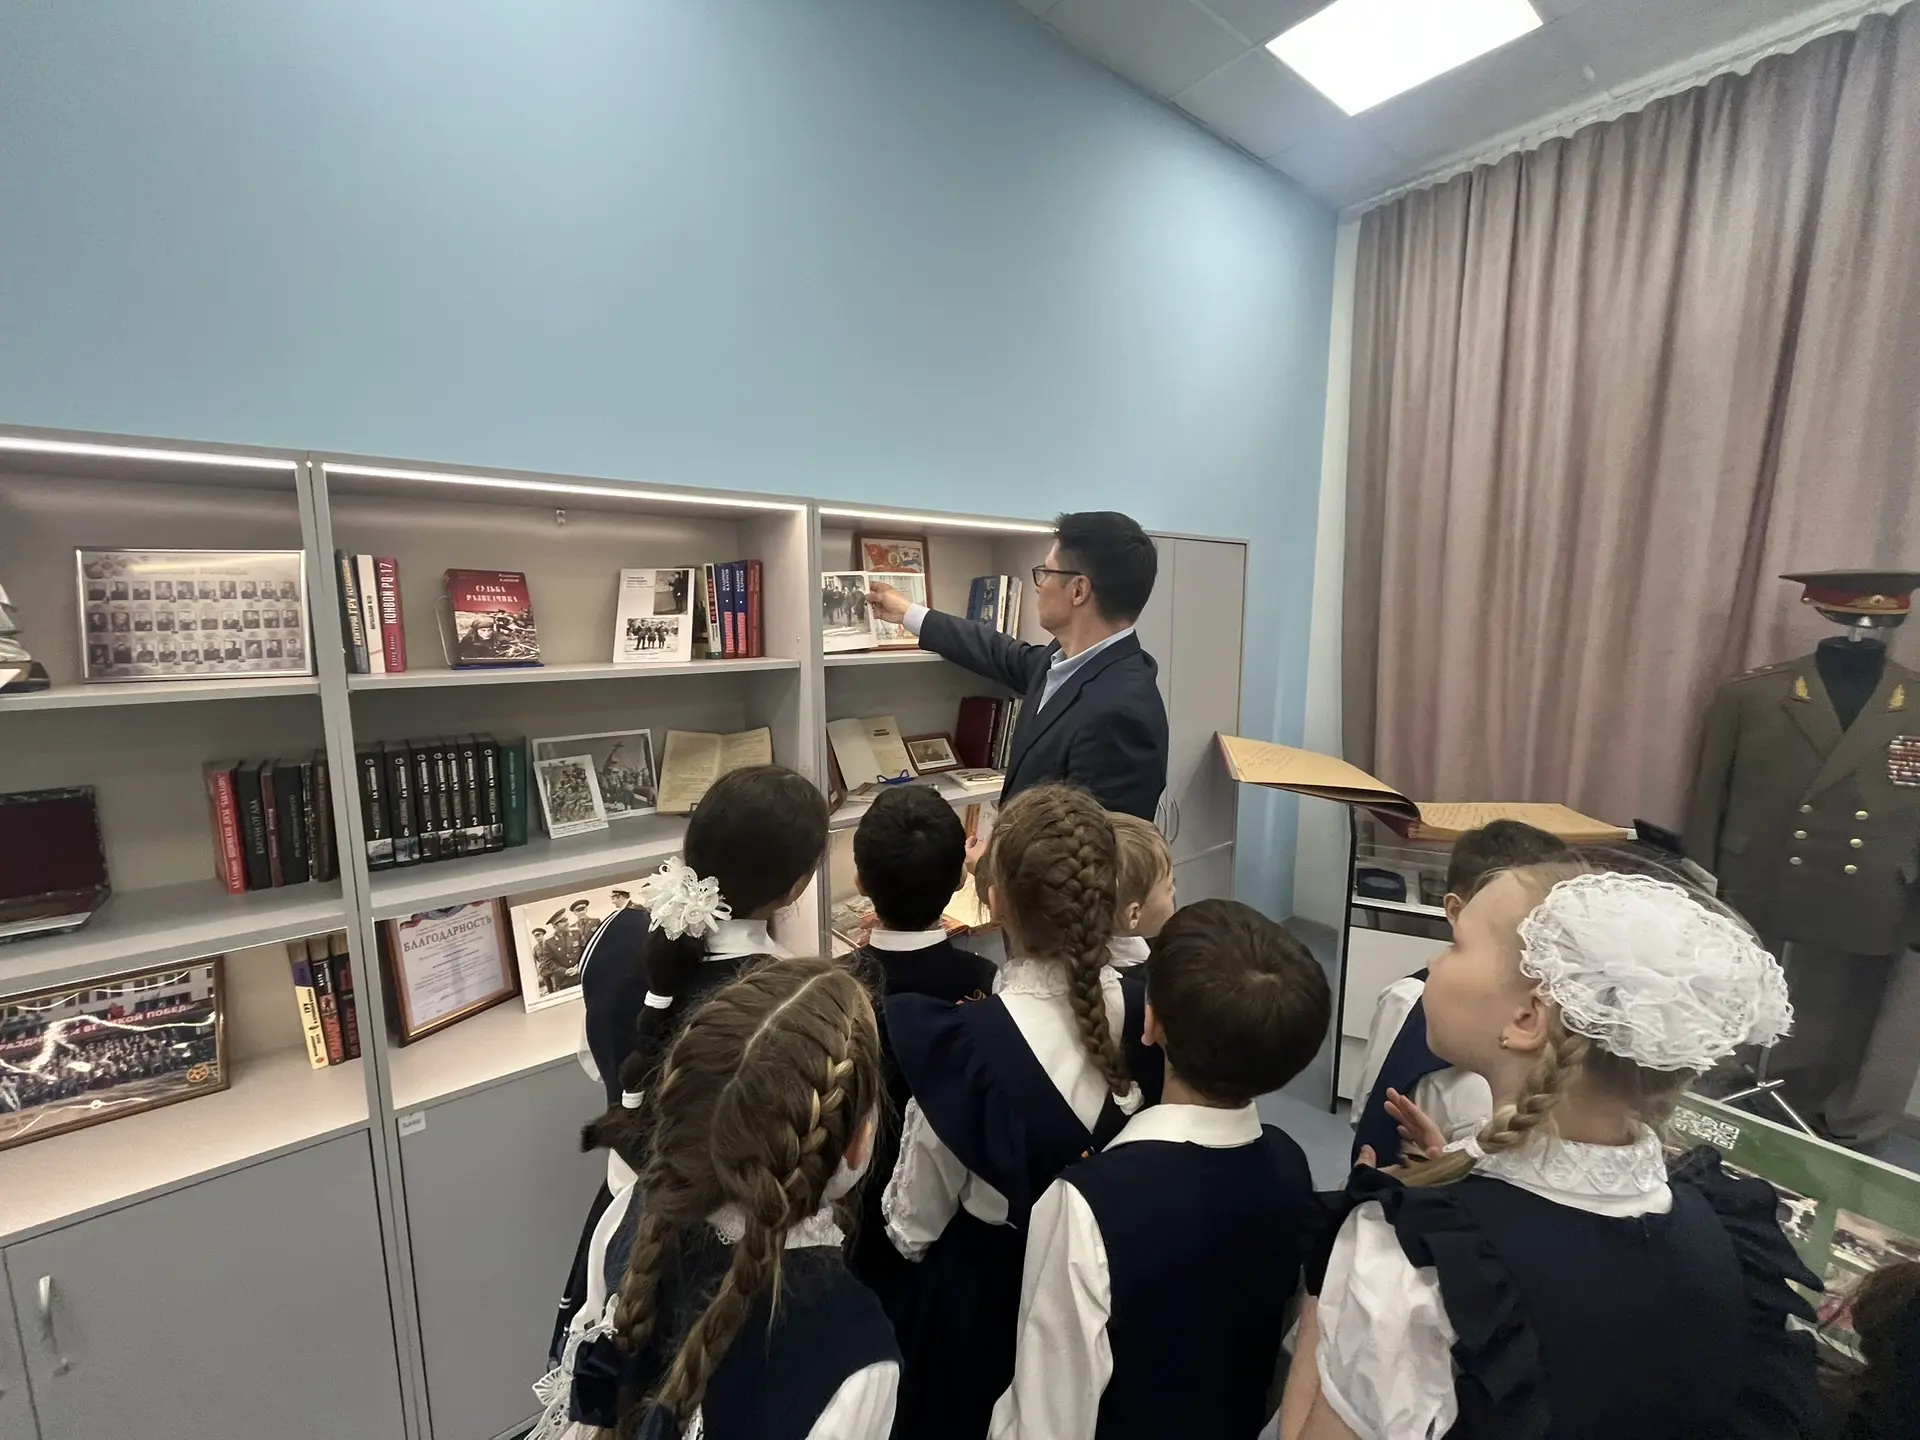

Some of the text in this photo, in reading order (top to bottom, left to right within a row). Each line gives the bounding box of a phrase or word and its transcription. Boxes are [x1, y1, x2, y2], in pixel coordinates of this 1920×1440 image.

[475, 585, 506, 593] СУДЬБА
[466, 594, 518, 603] РАЗВЕДЧИКА
[347, 596, 359, 614] ГРУ
[382, 590, 397, 624] КОНВОЙ
[443, 820, 448, 829] 4
[456, 819, 461, 828] 3
[472, 817, 478, 825] 2
[427, 822, 432, 831] 5
[404, 827, 410, 837] 6
[403, 915, 493, 952] БЛАГОДАРНОСТЬ
[147, 1001, 197, 1019] ПОБЕД
